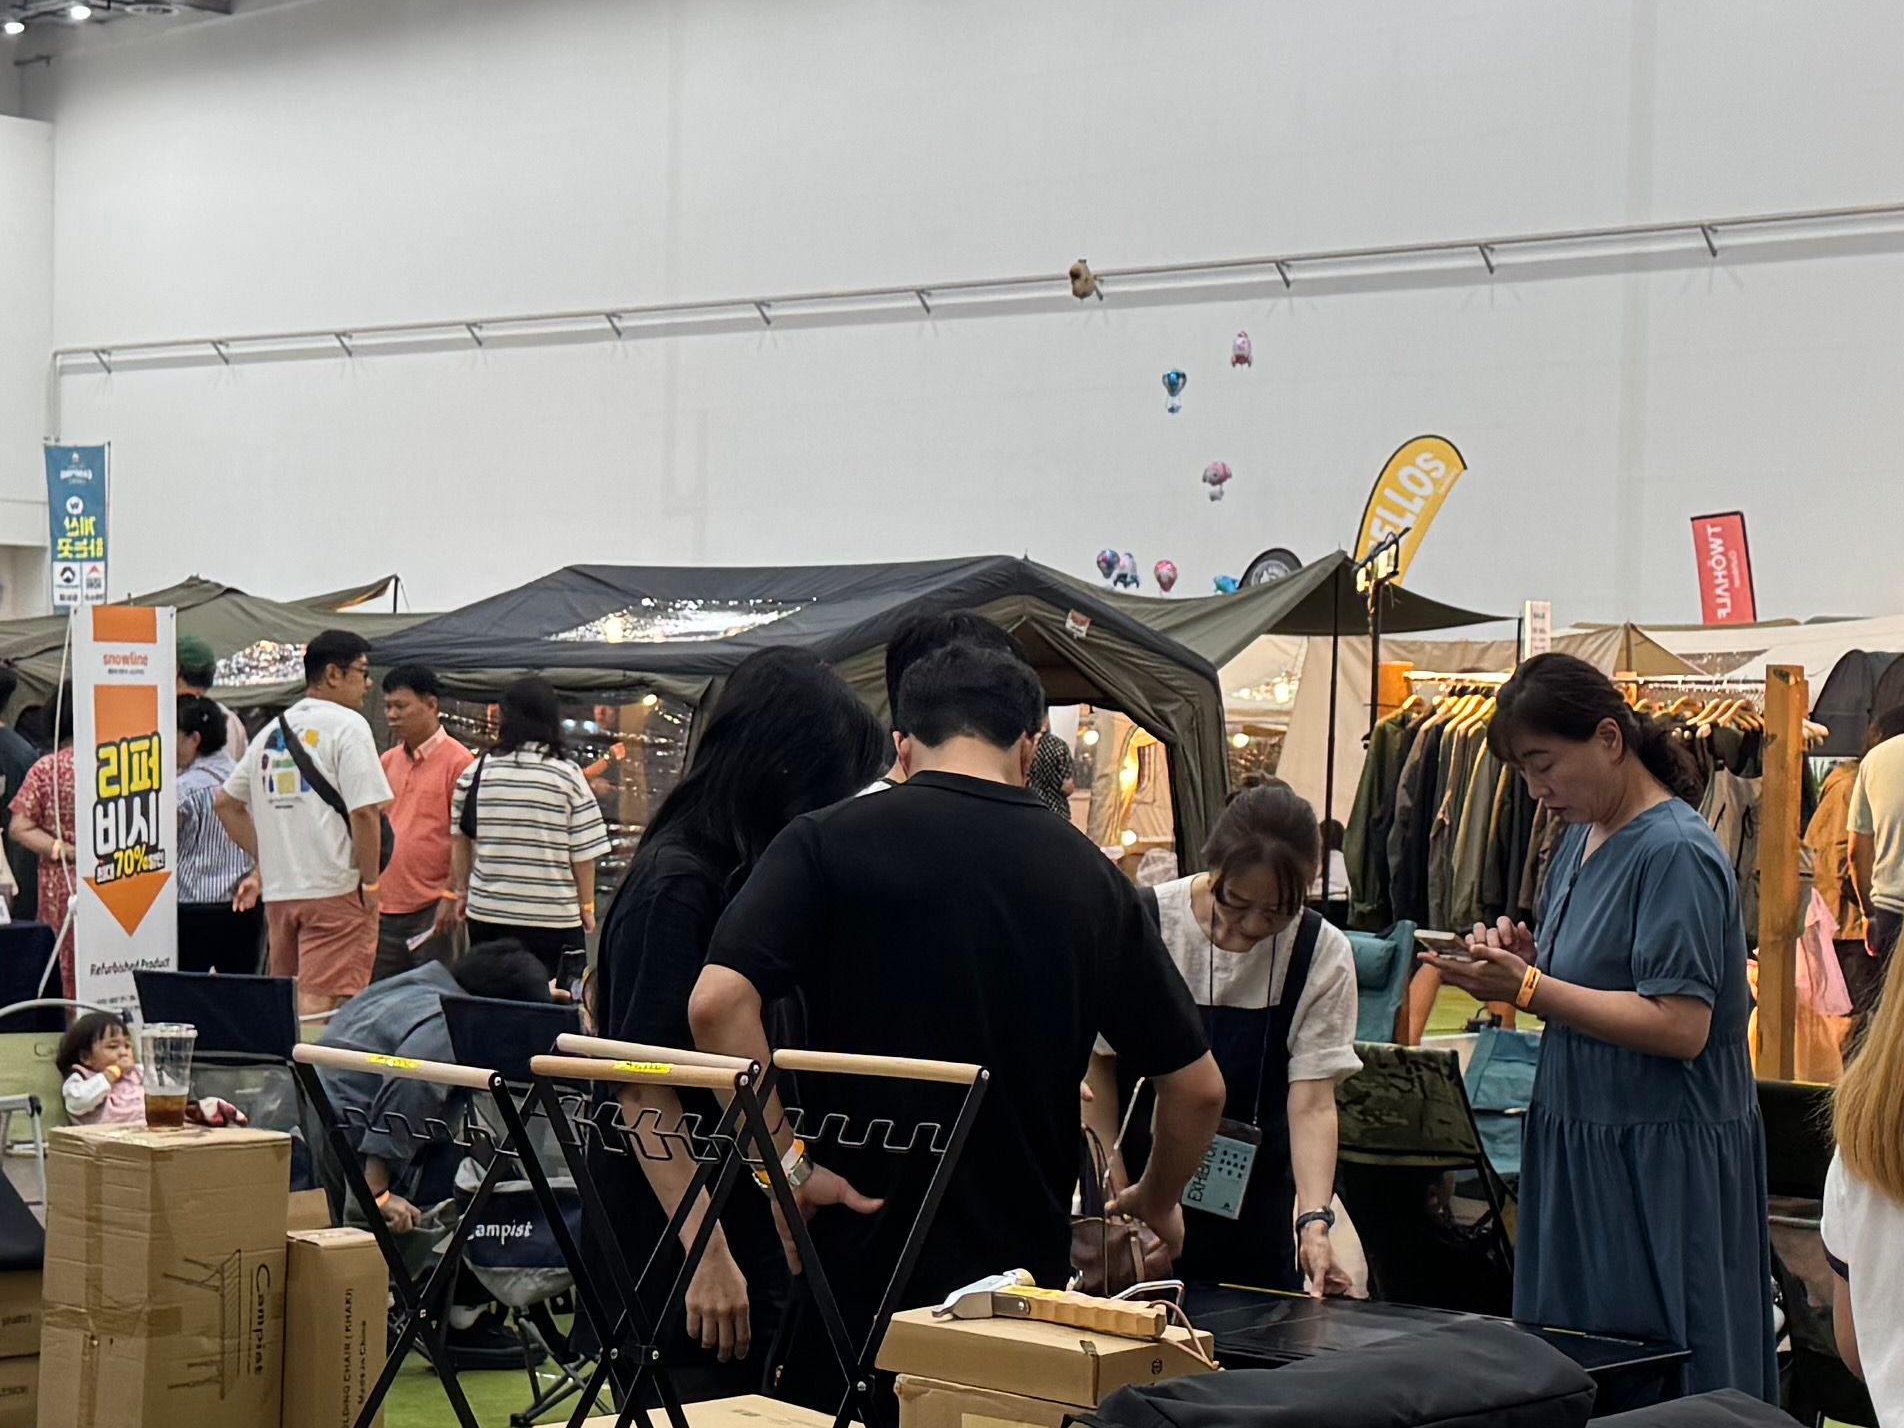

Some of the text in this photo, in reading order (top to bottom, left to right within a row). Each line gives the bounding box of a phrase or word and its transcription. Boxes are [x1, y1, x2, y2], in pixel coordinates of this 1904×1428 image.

[98, 736, 160, 798] 리퍼
[141, 957, 170, 970] Product
[467, 1220, 534, 1246] ampist
[252, 1264, 271, 1375] Campist
[344, 1342, 353, 1383] CHAIR
